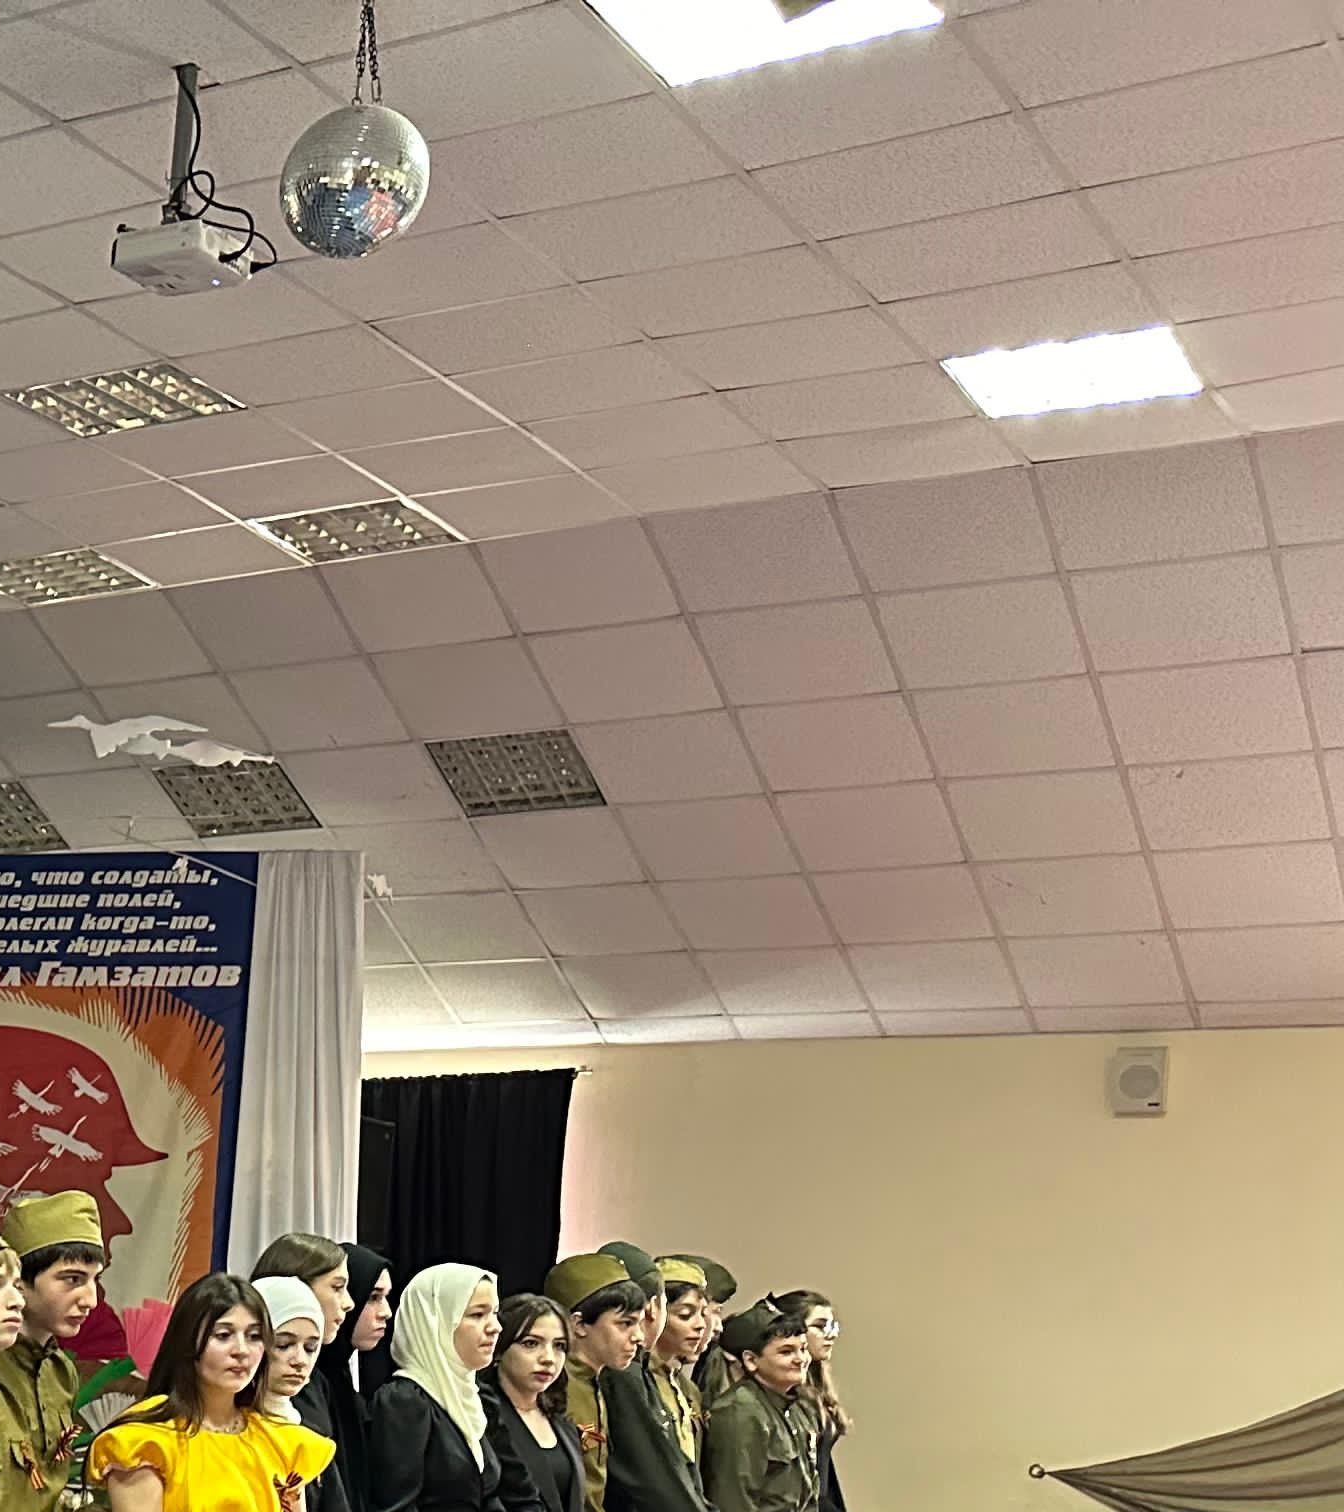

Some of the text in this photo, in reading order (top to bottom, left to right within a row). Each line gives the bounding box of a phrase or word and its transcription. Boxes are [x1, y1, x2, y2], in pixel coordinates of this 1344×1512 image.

[31, 871, 84, 886] что
[91, 869, 218, 887] солдаты,
[97, 889, 182, 910] полей,
[80, 913, 216, 934] когда-то,
[34, 960, 242, 988] Гамзатов
